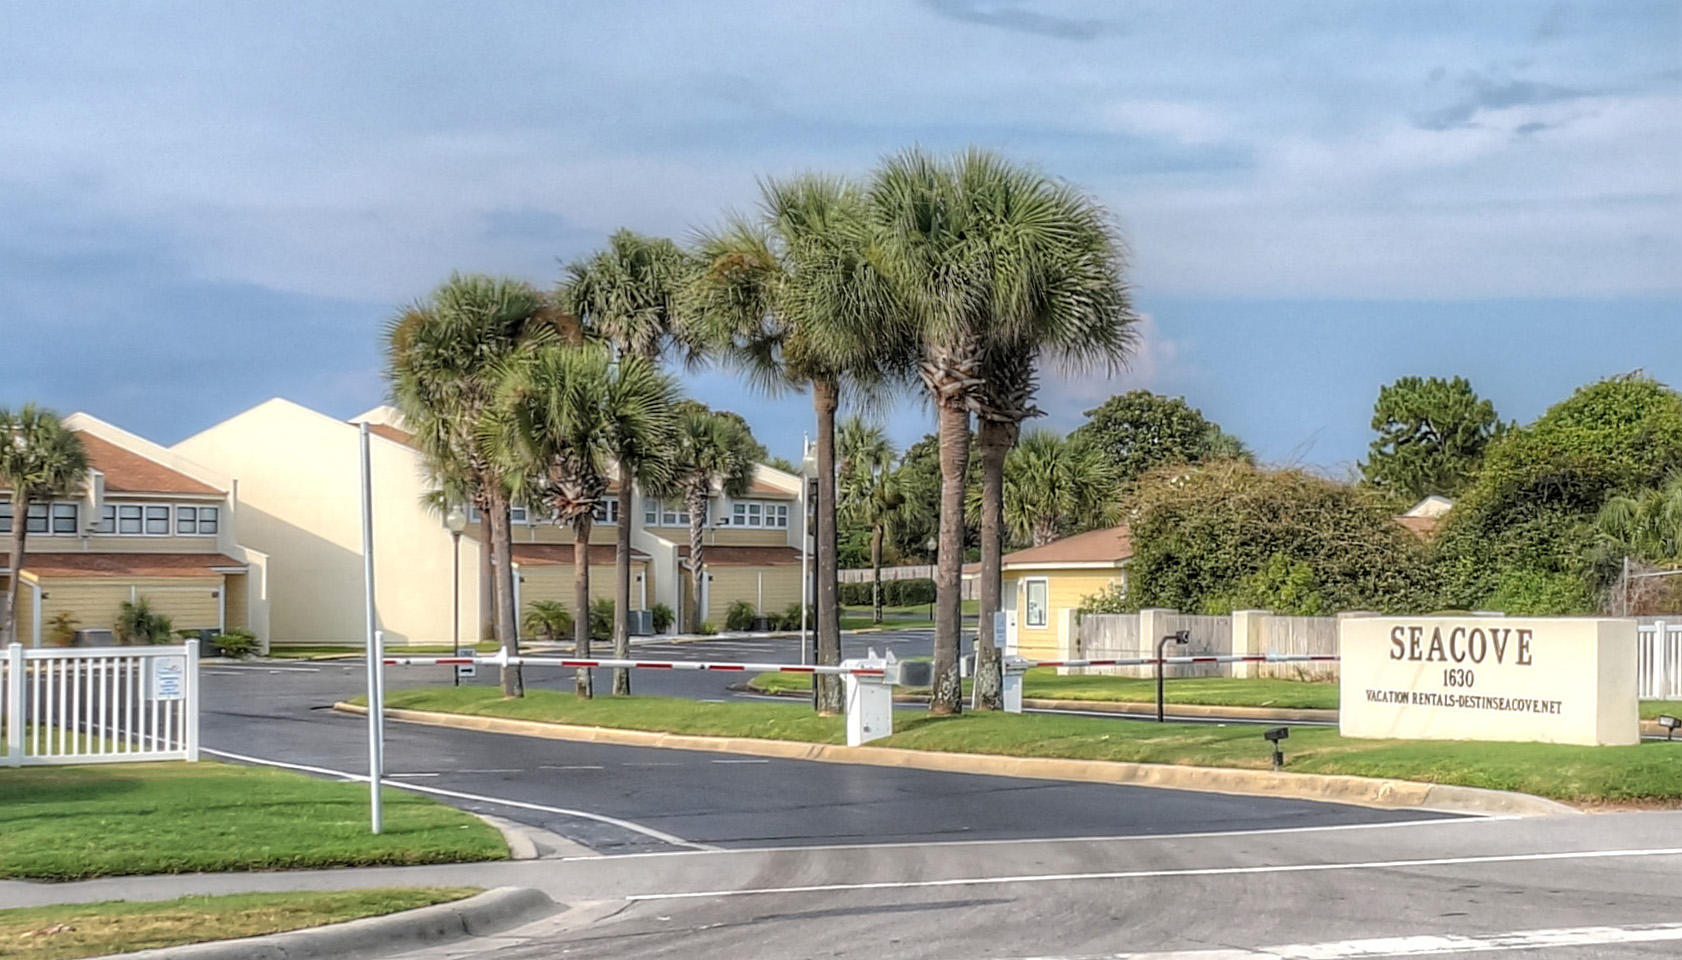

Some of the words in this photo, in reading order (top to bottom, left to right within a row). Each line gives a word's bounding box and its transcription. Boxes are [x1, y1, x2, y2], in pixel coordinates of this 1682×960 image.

[1390, 626, 1532, 665] SEACOVE
[1443, 669, 1474, 687] 1630
[1366, 689, 1409, 704] VACATION
